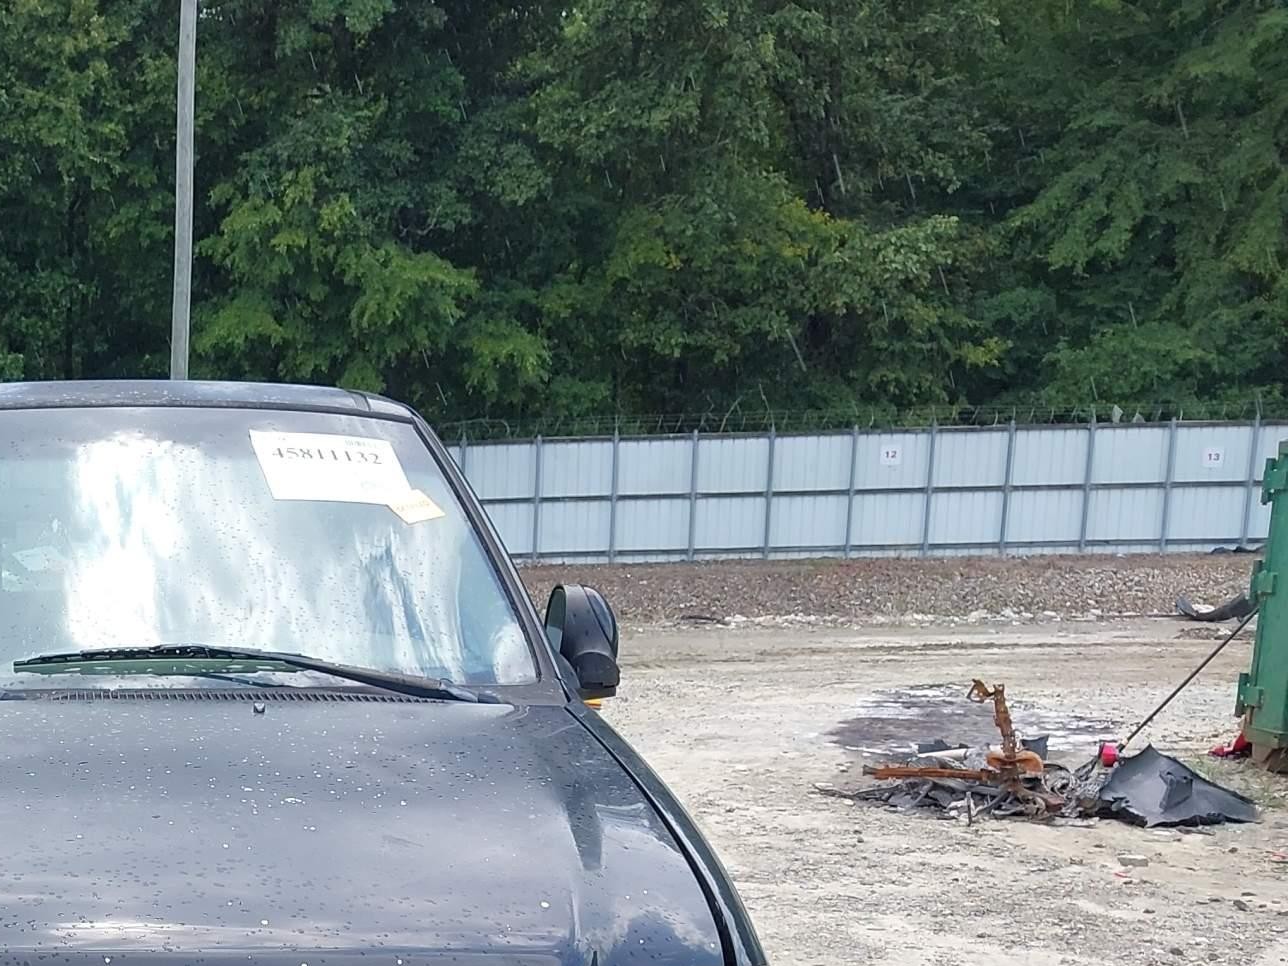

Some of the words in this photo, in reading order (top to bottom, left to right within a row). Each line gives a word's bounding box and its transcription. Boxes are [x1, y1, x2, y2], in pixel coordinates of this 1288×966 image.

[272, 447, 382, 465] 45811132
[885, 450, 897, 459] 12
[1208, 452, 1220, 461] 13
